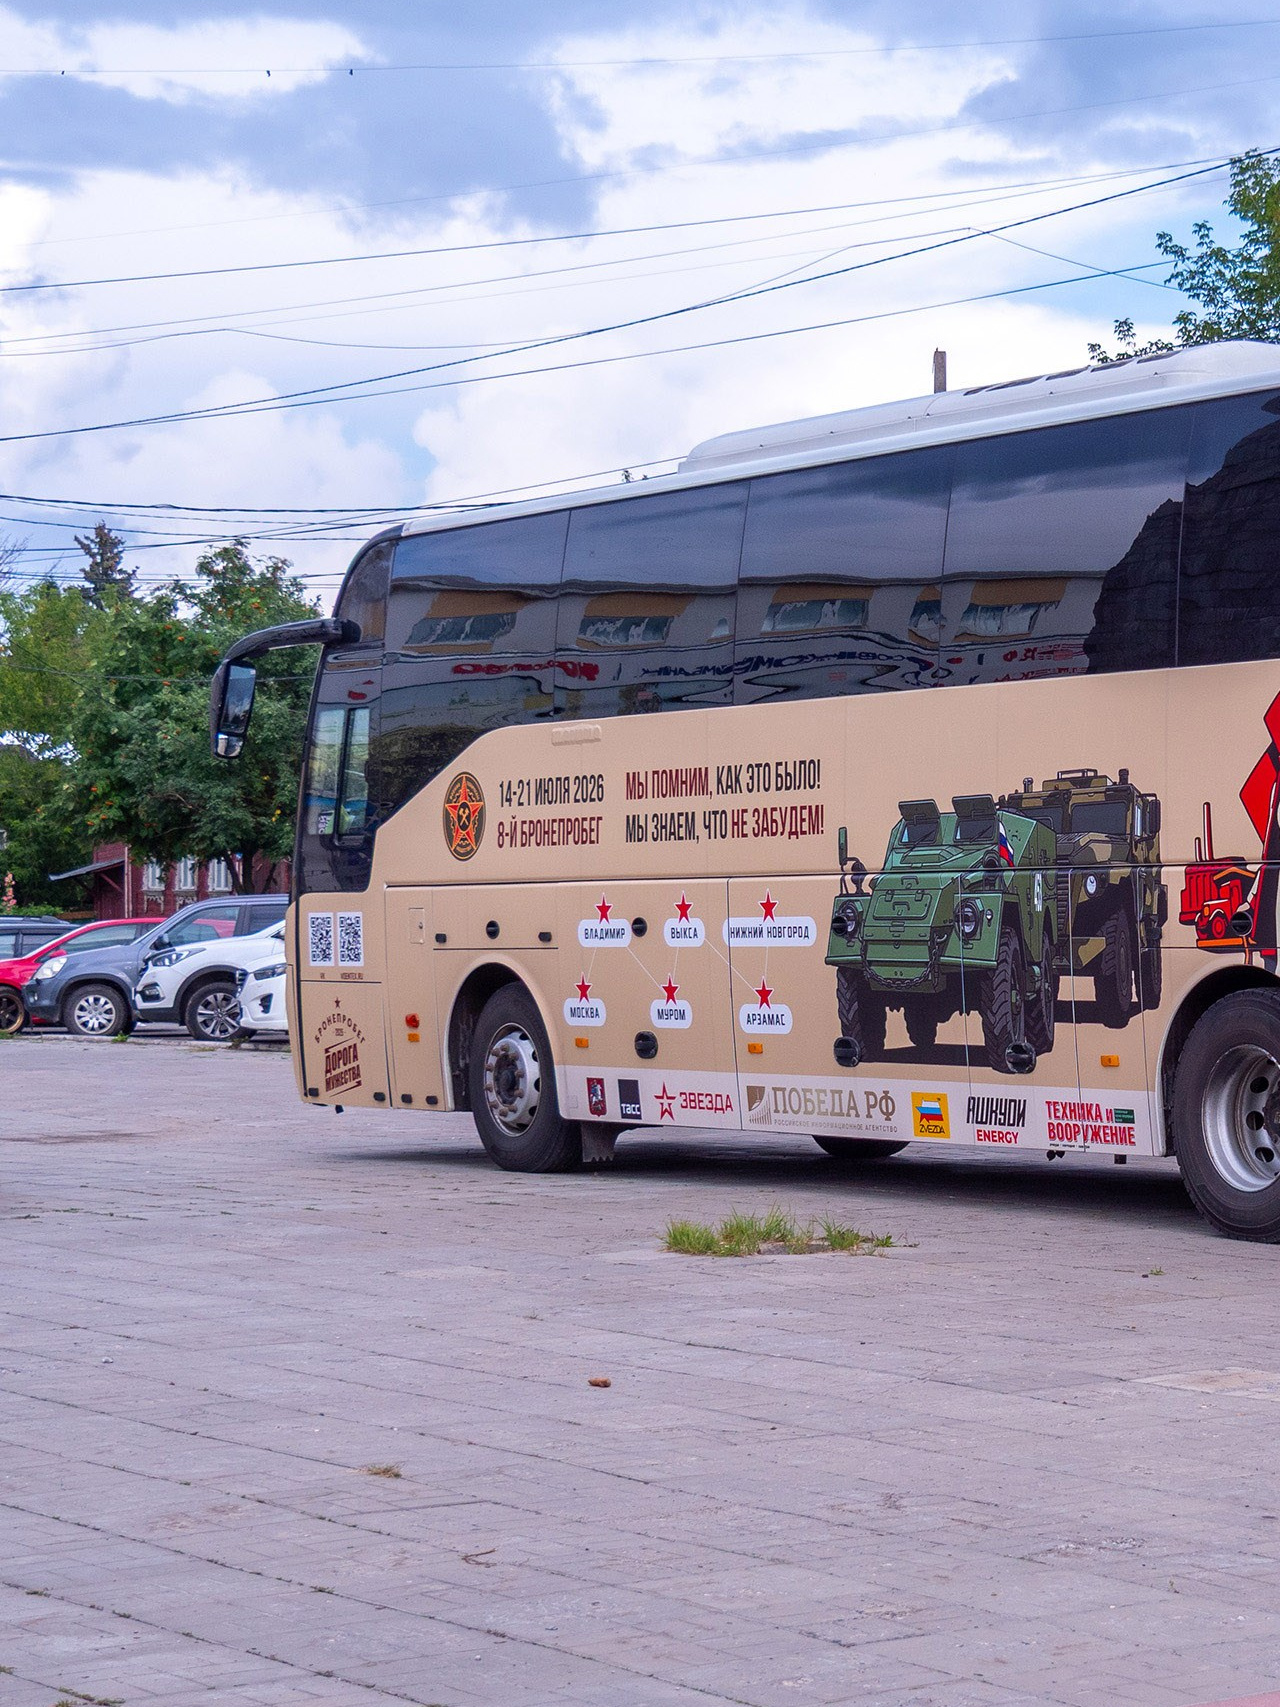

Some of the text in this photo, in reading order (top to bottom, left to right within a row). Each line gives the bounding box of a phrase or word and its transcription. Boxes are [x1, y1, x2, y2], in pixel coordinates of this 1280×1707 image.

[499, 779, 531, 808] 14-21
[534, 776, 570, 806] ИЮЛЯ
[573, 774, 604, 804] 2026
[626, 759, 821, 801] МЫ ПОМНИМ, КАК ЭТО БЫЛО!
[497, 815, 603, 849] 8-Й БРОНЕПРОБЕГ
[625, 804, 824, 844] МЫ ЗНАЕМ, ЧТО НЕ ЗАБУДЕМ!
[584, 927, 626, 940] ВЛАДИМИР
[670, 926, 698, 939] ВЫКСА
[730, 924, 810, 939] НИЖНИЙ НОВГОРОД
[570, 1006, 600, 1019] МОСКВА
[657, 1008, 686, 1021] МУРОМ
[746, 1012, 786, 1026] АРЗАМАС
[315, 1013, 366, 1044] БРОНЕПРОБЕГ
[325, 1043, 358, 1077] ДОРОГА
[325, 1064, 361, 1092] МУЖЕСТВА
[679, 1091, 734, 1114] ЗВЕЗДА
[771, 1086, 896, 1121] ПОБЕДА РФ
[1045, 1100, 1103, 1123] ТЕХНИКА
[865, 1123, 898, 1133] АГЕНТСТВО
[919, 1124, 945, 1134] ZVEZDA
[976, 1128, 1019, 1144] ENERGY
[1047, 1121, 1136, 1146] ВООРУЖЕНИЕ
